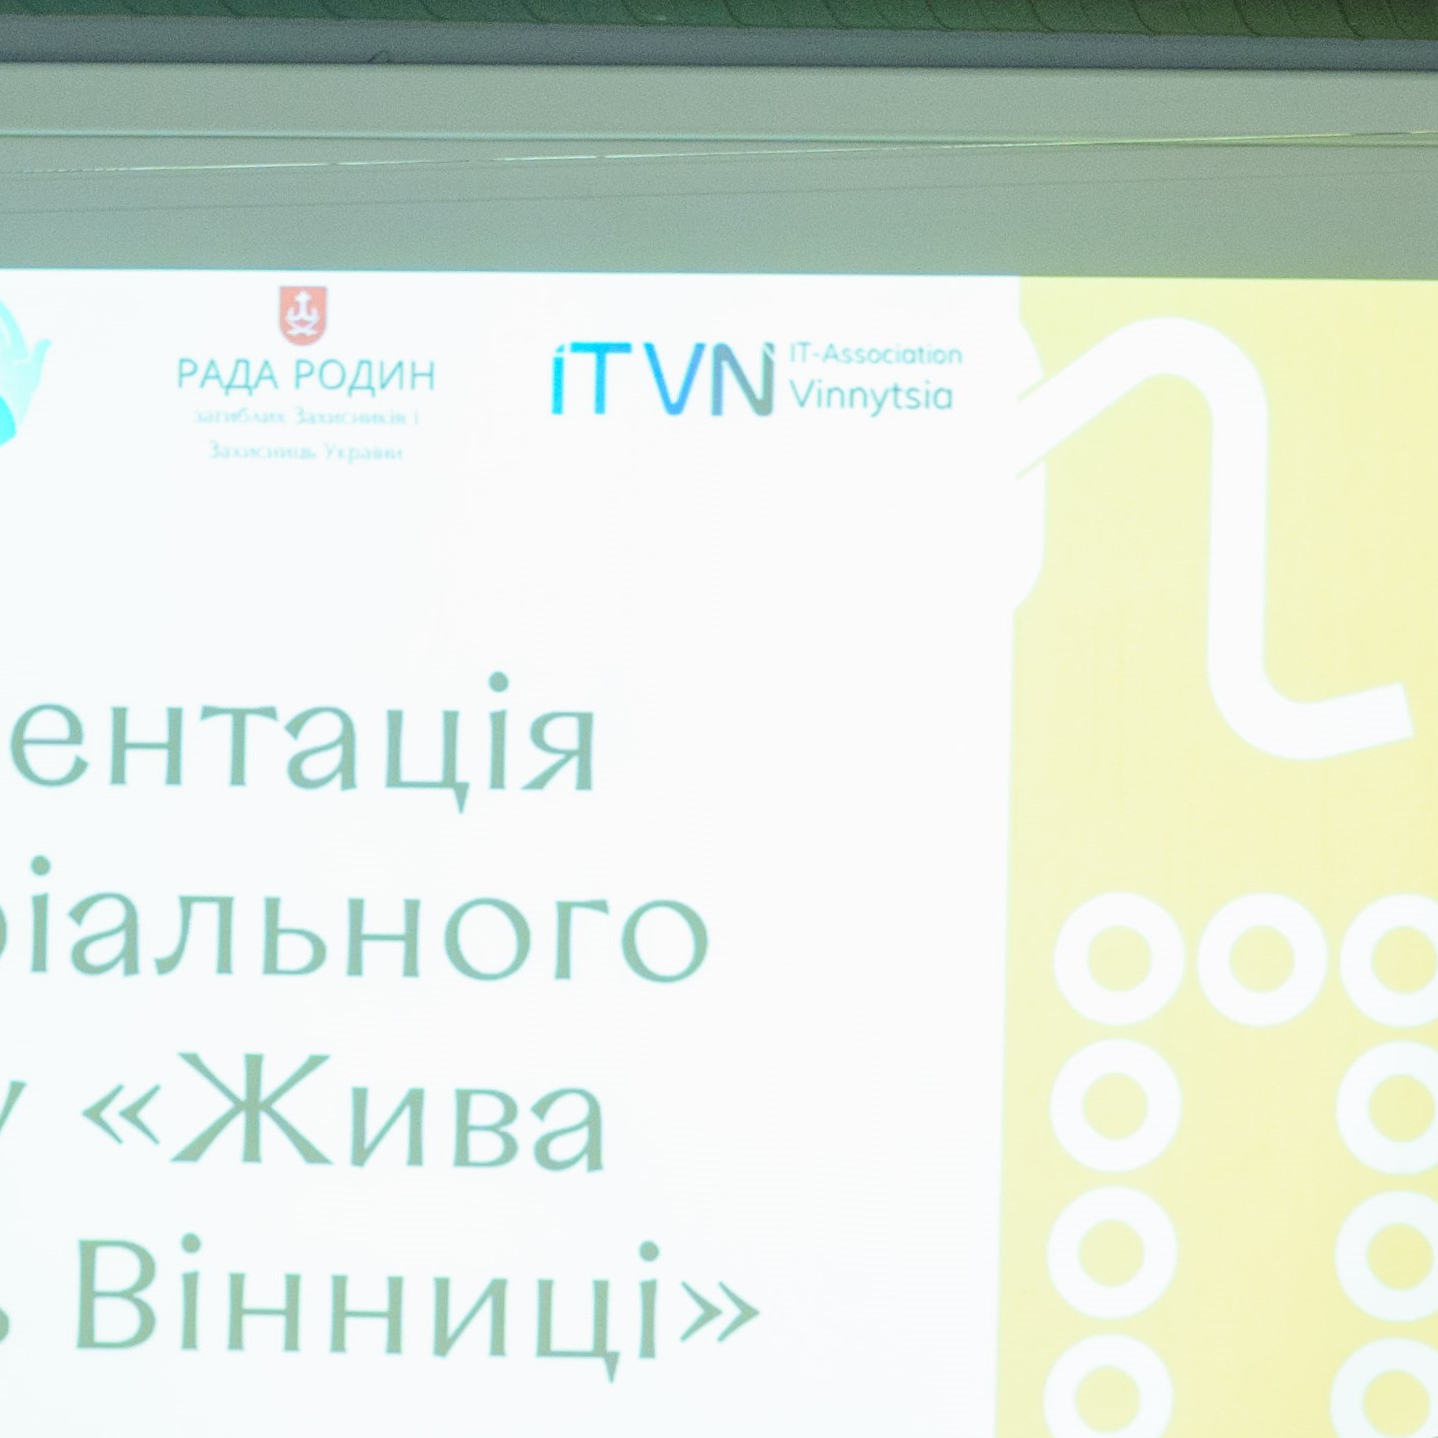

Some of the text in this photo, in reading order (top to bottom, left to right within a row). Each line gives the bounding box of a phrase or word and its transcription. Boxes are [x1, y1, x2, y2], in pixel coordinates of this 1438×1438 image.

[788, 339, 964, 367] IT-Association
[176, 356, 436, 399] РАДА РОДИН
[787, 378, 955, 419] Vinnytsia
[80, 1050, 605, 1175] «Жива
[74, 1230, 761, 1385] Вінниці»
